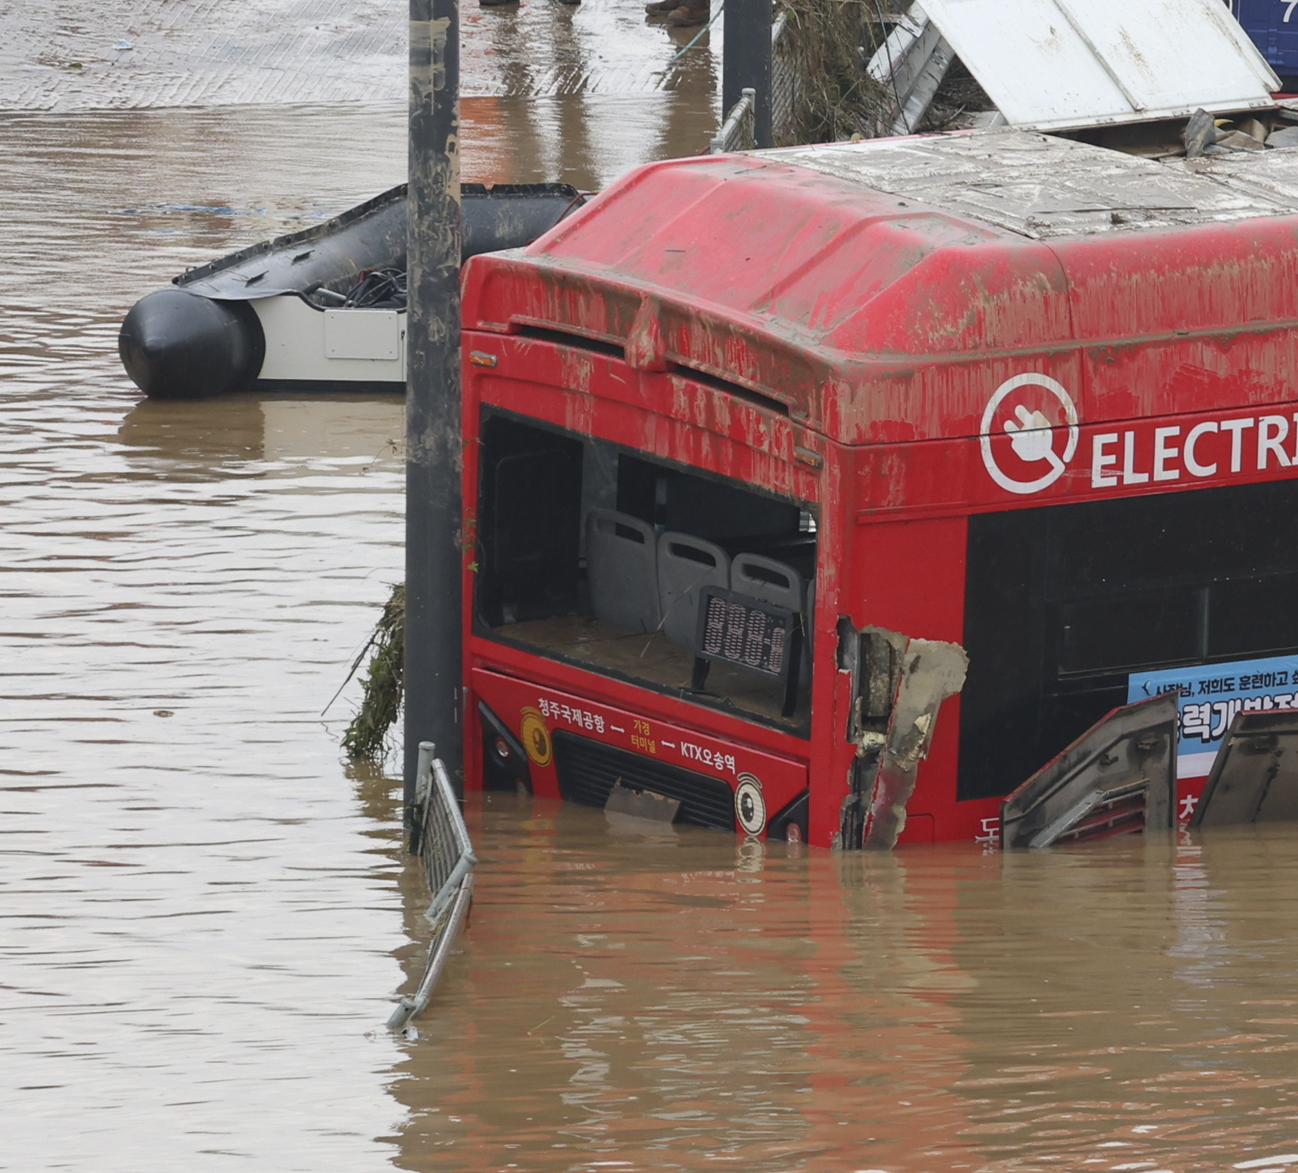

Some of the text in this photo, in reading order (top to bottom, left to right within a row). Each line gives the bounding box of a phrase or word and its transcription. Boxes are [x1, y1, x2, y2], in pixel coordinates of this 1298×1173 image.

[1198, 677, 1235, 695] 저희도
[1239, 671, 1288, 690] 훈련하고
[538, 698, 605, 734] 청주국제공항
[633, 719, 650, 735] 가경
[630, 735, 656, 754] 터미널
[680, 741, 735, 775] KTX오송역
